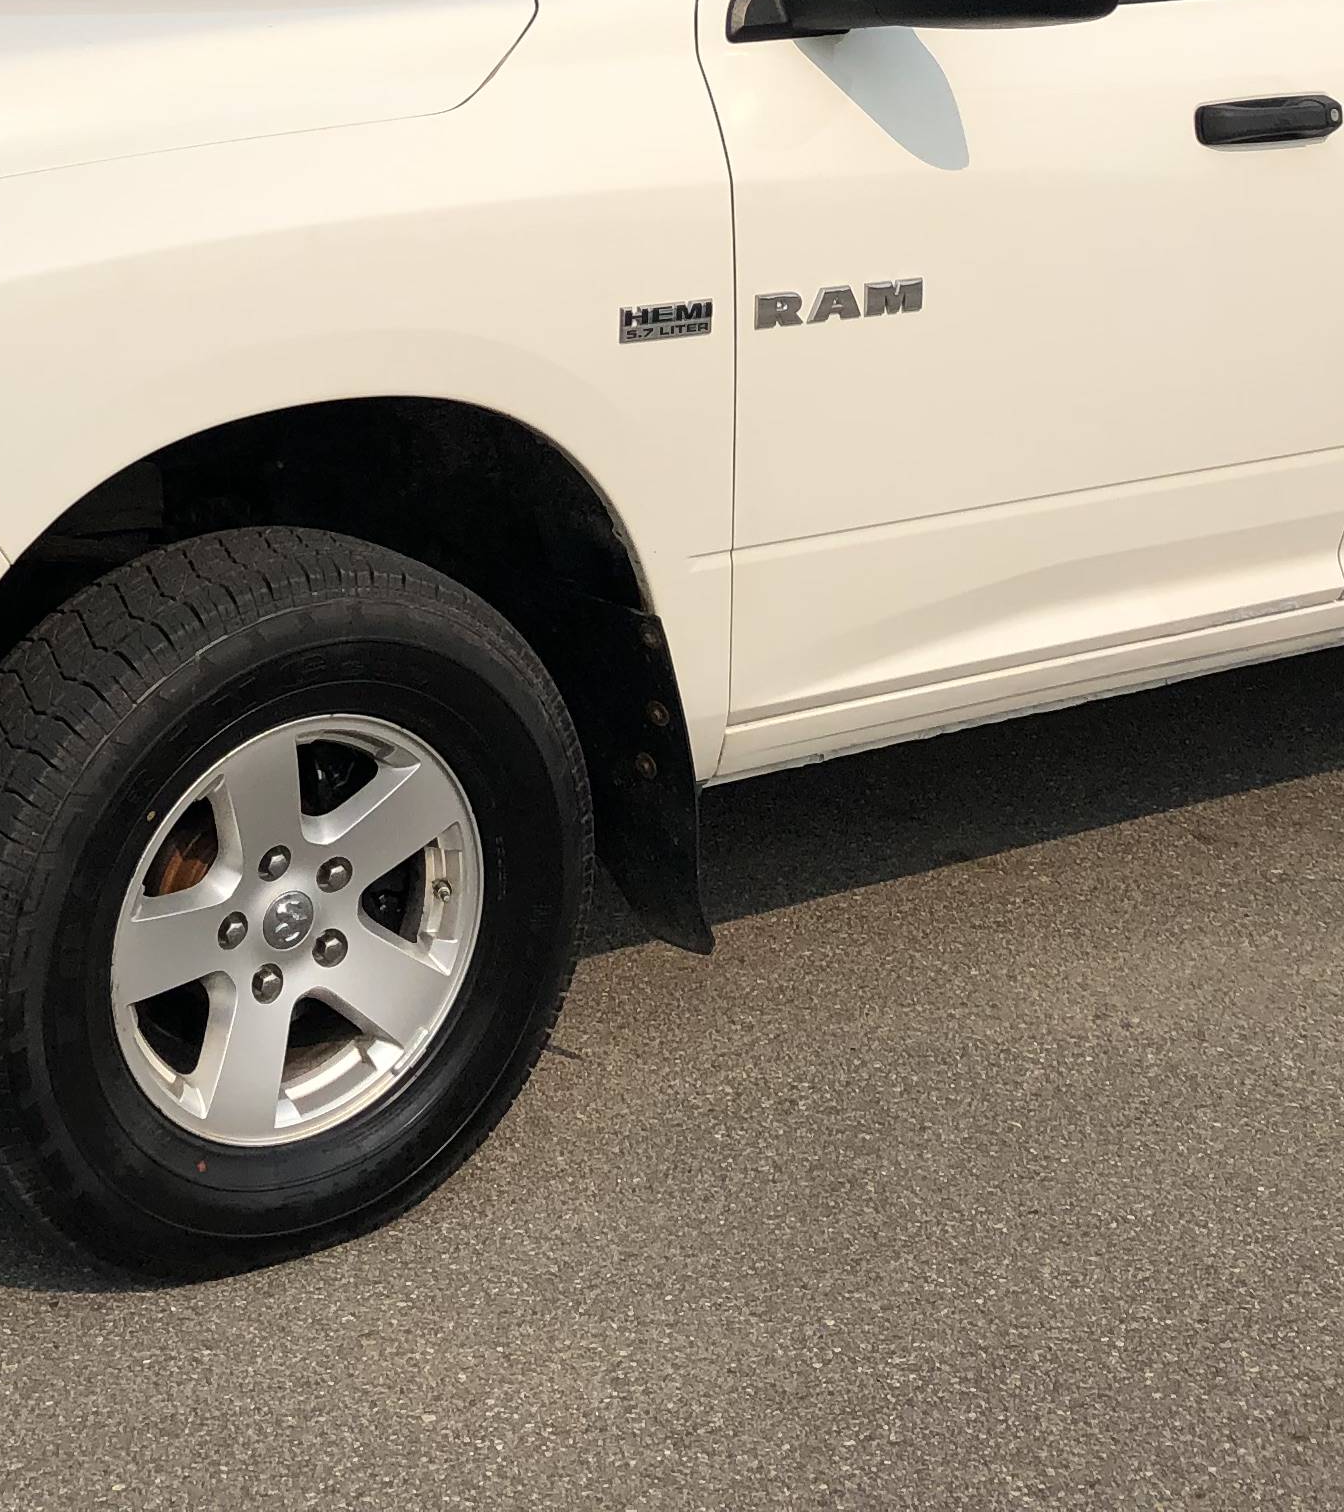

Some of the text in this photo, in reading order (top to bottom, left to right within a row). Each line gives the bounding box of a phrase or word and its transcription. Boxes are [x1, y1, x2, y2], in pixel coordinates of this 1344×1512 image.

[623, 301, 713, 327] HEMI
[754, 277, 924, 331] RAM
[626, 322, 709, 340] 5.7 LITER
